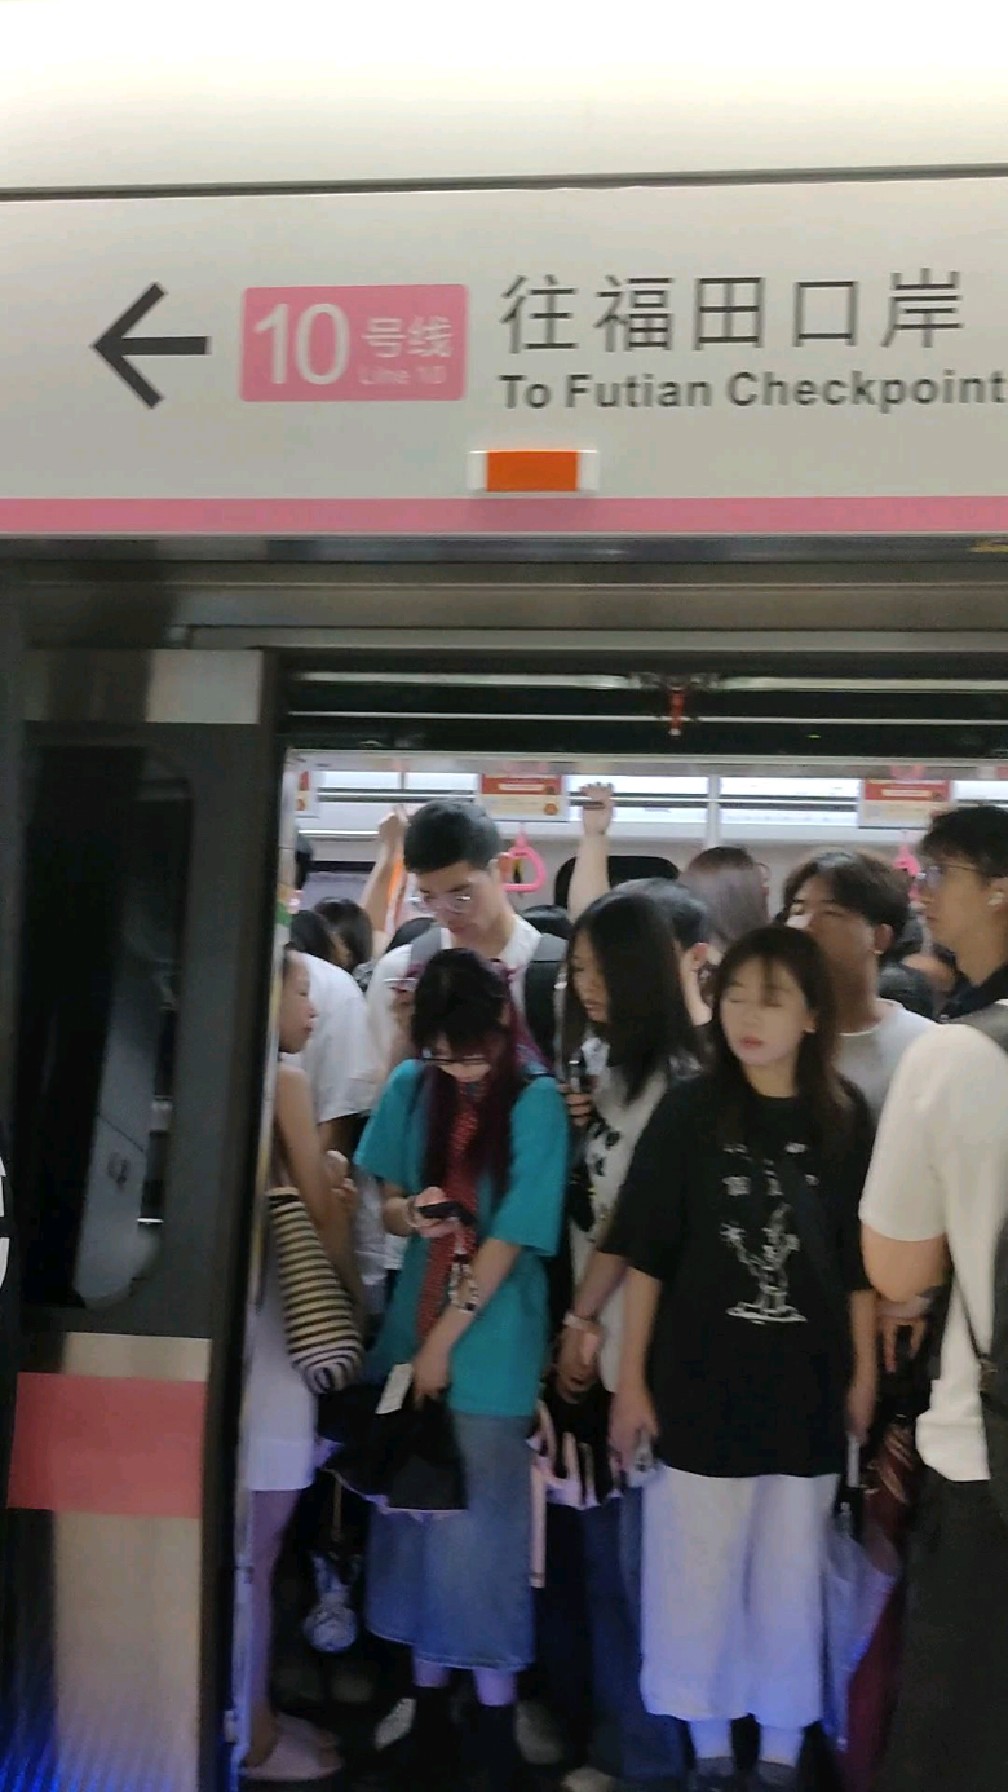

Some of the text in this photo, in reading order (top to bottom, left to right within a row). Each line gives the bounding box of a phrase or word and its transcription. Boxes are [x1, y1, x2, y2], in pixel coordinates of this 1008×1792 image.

[361, 315, 454, 358] 号线
[501, 268, 964, 353] 往福田口岸
[254, 302, 350, 385] 10
[499, 369, 1008, 413] To Futian Checkpoint
